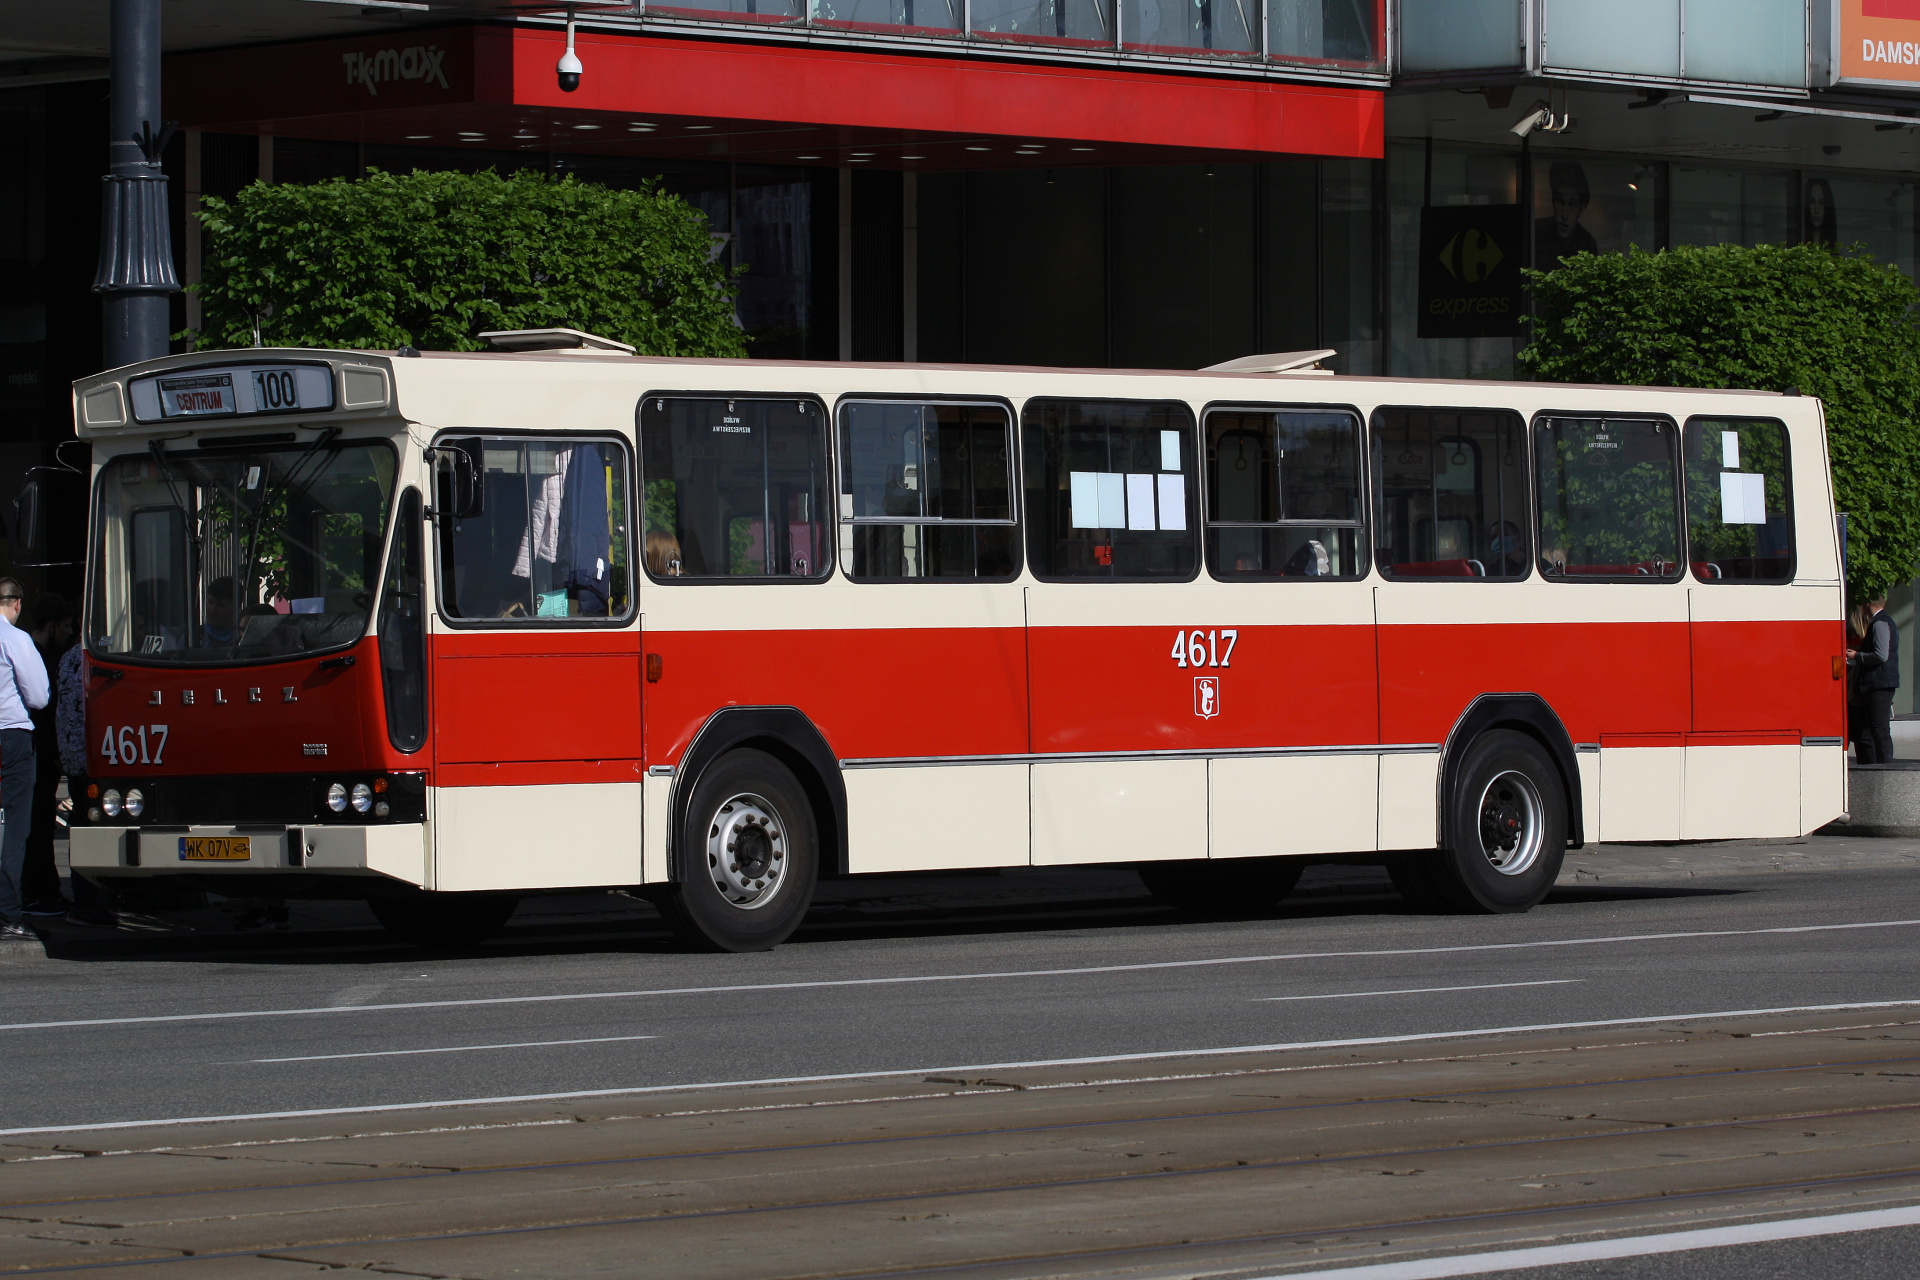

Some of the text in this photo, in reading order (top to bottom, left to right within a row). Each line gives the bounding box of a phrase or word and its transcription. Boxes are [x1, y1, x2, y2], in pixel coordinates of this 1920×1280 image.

[1429, 297, 1510, 320] express
[258, 372, 296, 408] 100
[176, 391, 223, 411] CENTRUM
[143, 636, 162, 654] M2
[1170, 629, 1238, 668] 4617
[148, 686, 298, 705] JELCZ
[101, 724, 169, 766] 4617
[187, 840, 204, 857] WK
[208, 840, 231, 857] 07V
